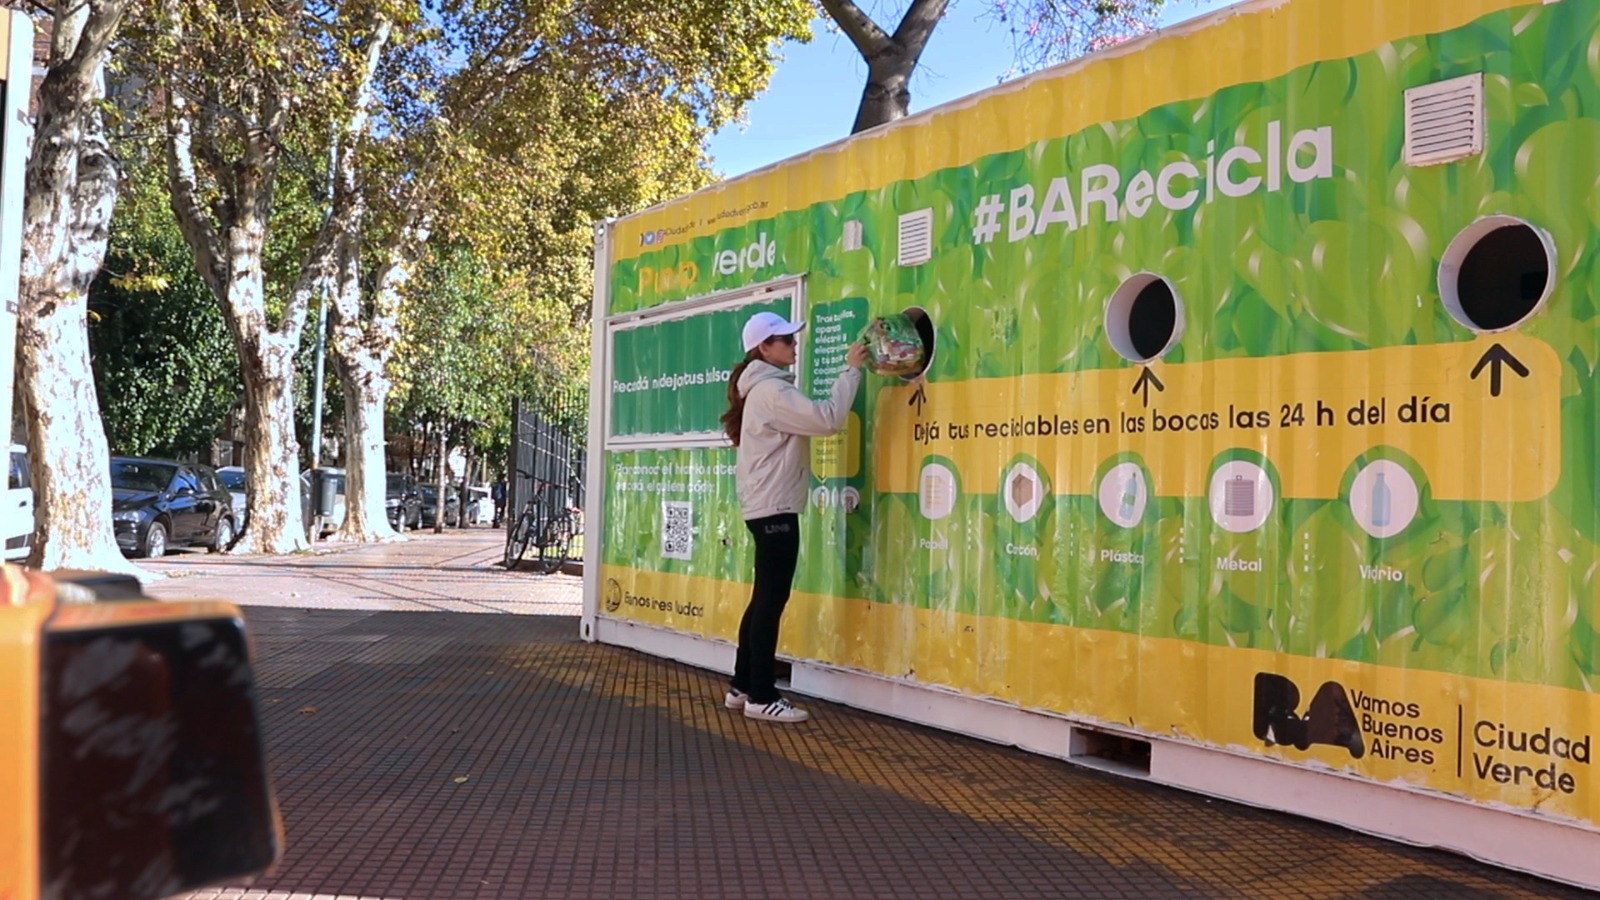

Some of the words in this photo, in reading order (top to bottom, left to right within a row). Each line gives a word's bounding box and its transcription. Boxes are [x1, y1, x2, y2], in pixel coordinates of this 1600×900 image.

[972, 119, 1334, 246] #BARecicla
[914, 420, 940, 446] Dejá
[948, 421, 970, 440] tus
[974, 414, 1079, 439] reciclables
[1083, 415, 1110, 435] en
[1121, 411, 1145, 434] las
[1152, 408, 1220, 433] bocas
[1229, 404, 1271, 429] las
[1280, 402, 1306, 428] 24
[1316, 400, 1335, 427] h
[1347, 397, 1386, 426] del
[1397, 395, 1452, 424] día
[1216, 556, 1262, 572] Metal
[1359, 564, 1403, 582] Vidrio
[1350, 688, 1421, 719] Vamos
[1361, 713, 1444, 744] Buenos
[1473, 719, 1592, 765] Ciudad
[1370, 738, 1435, 765] Aires
[1472, 751, 1577, 794] Verde
